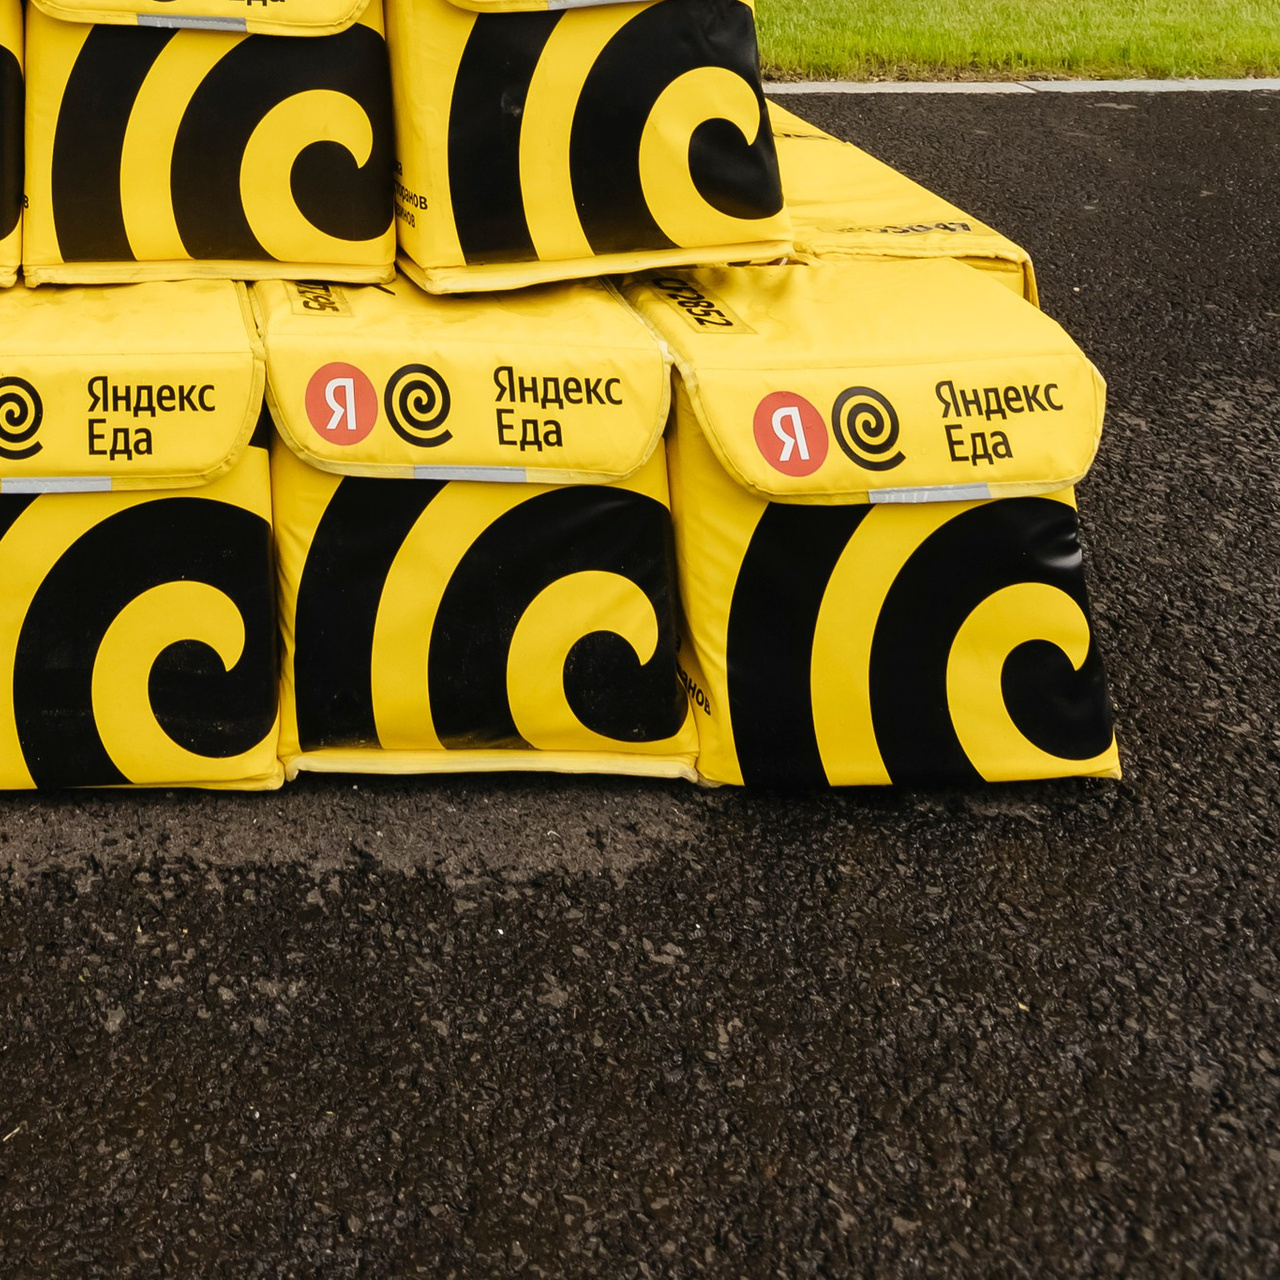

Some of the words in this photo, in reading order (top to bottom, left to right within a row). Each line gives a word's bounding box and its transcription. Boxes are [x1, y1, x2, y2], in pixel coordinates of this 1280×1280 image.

[87, 375, 216, 418] Яндекс
[493, 365, 623, 410] Яндекс
[935, 380, 1064, 421] Яндекс
[88, 418, 153, 461] Еда
[495, 408, 563, 452] Еда
[944, 424, 1014, 467] Еда
